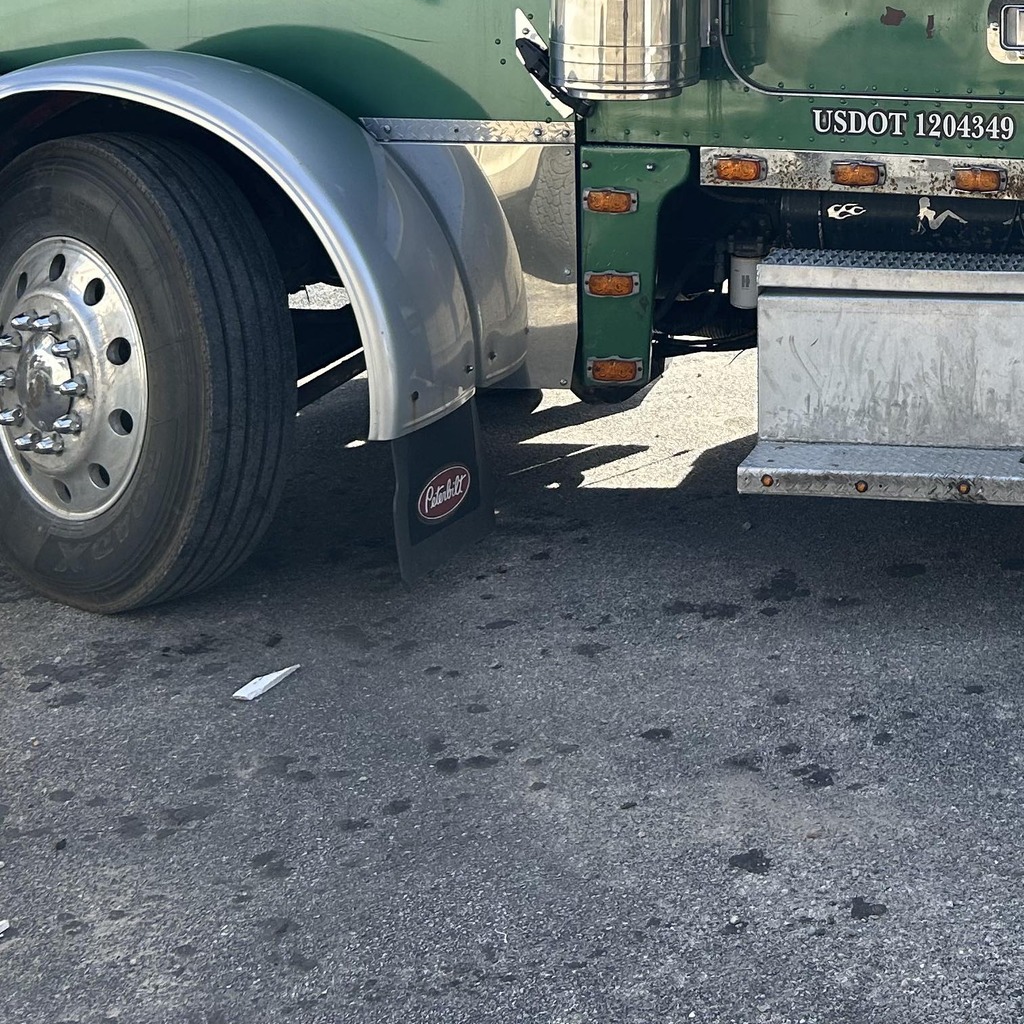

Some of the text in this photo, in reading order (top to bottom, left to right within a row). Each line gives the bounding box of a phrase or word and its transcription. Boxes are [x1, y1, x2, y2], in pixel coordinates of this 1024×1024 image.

[812, 109, 1015, 140] USDOT 1204349
[425, 474, 467, 513] Peterbilt
